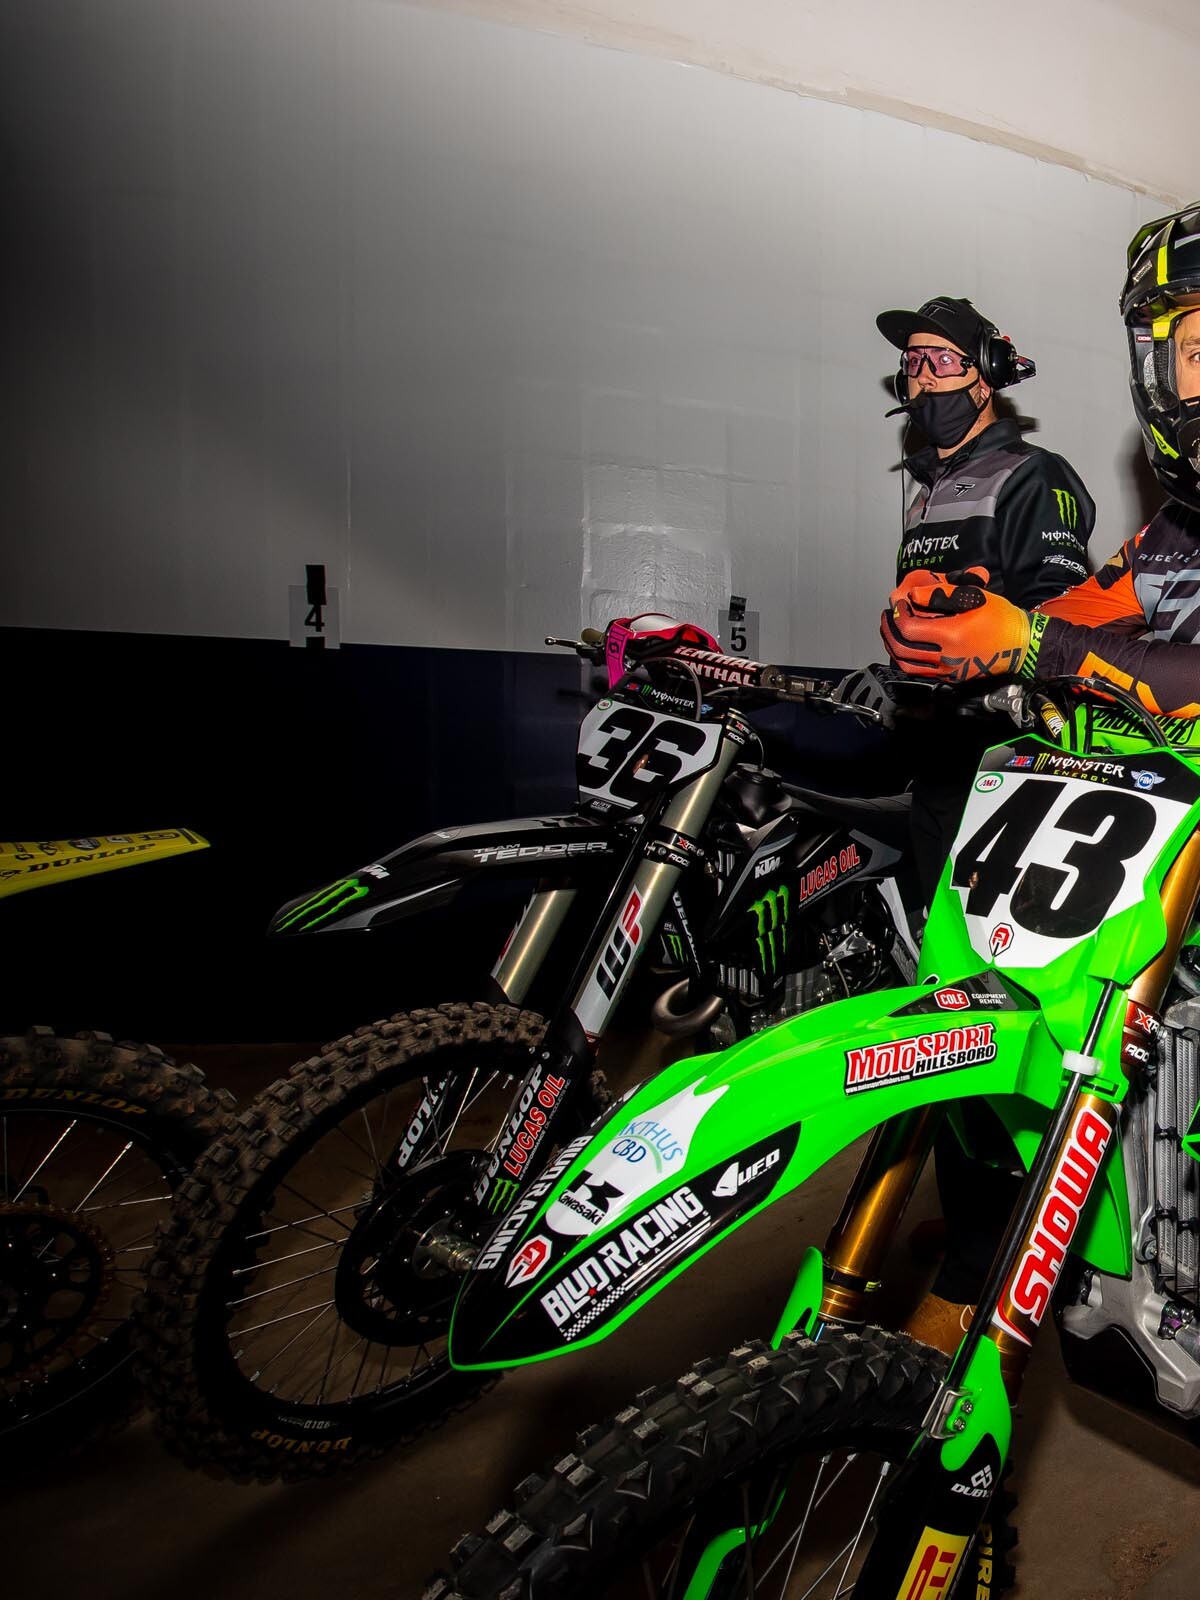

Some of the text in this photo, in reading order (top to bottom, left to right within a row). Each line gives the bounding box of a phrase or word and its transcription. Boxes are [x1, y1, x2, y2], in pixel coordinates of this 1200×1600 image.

[304, 604, 326, 632] 4
[730, 627, 747, 652] 5
[577, 707, 707, 804] 36
[1048, 754, 1126, 778] MONSTER
[26, 842, 156, 873] DUNLOP
[473, 841, 608, 863] TEDDER
[755, 856, 781, 879] KTM
[951, 778, 1157, 938] 43
[800, 855, 838, 902] LUCAS
[839, 843, 860, 873] OIL
[940, 993, 966, 1005] COLE
[914, 1045, 995, 1075] HILLSBORO
[503, 1073, 566, 1178] LUCAS OIL
[612, 1138, 647, 1163] CBD
[737, 1149, 780, 1187] UFO
[557, 1189, 606, 1226] Kawasaki
[1010, 1108, 1112, 1327] SHOWA
[597, 1186, 704, 1278] RACING
